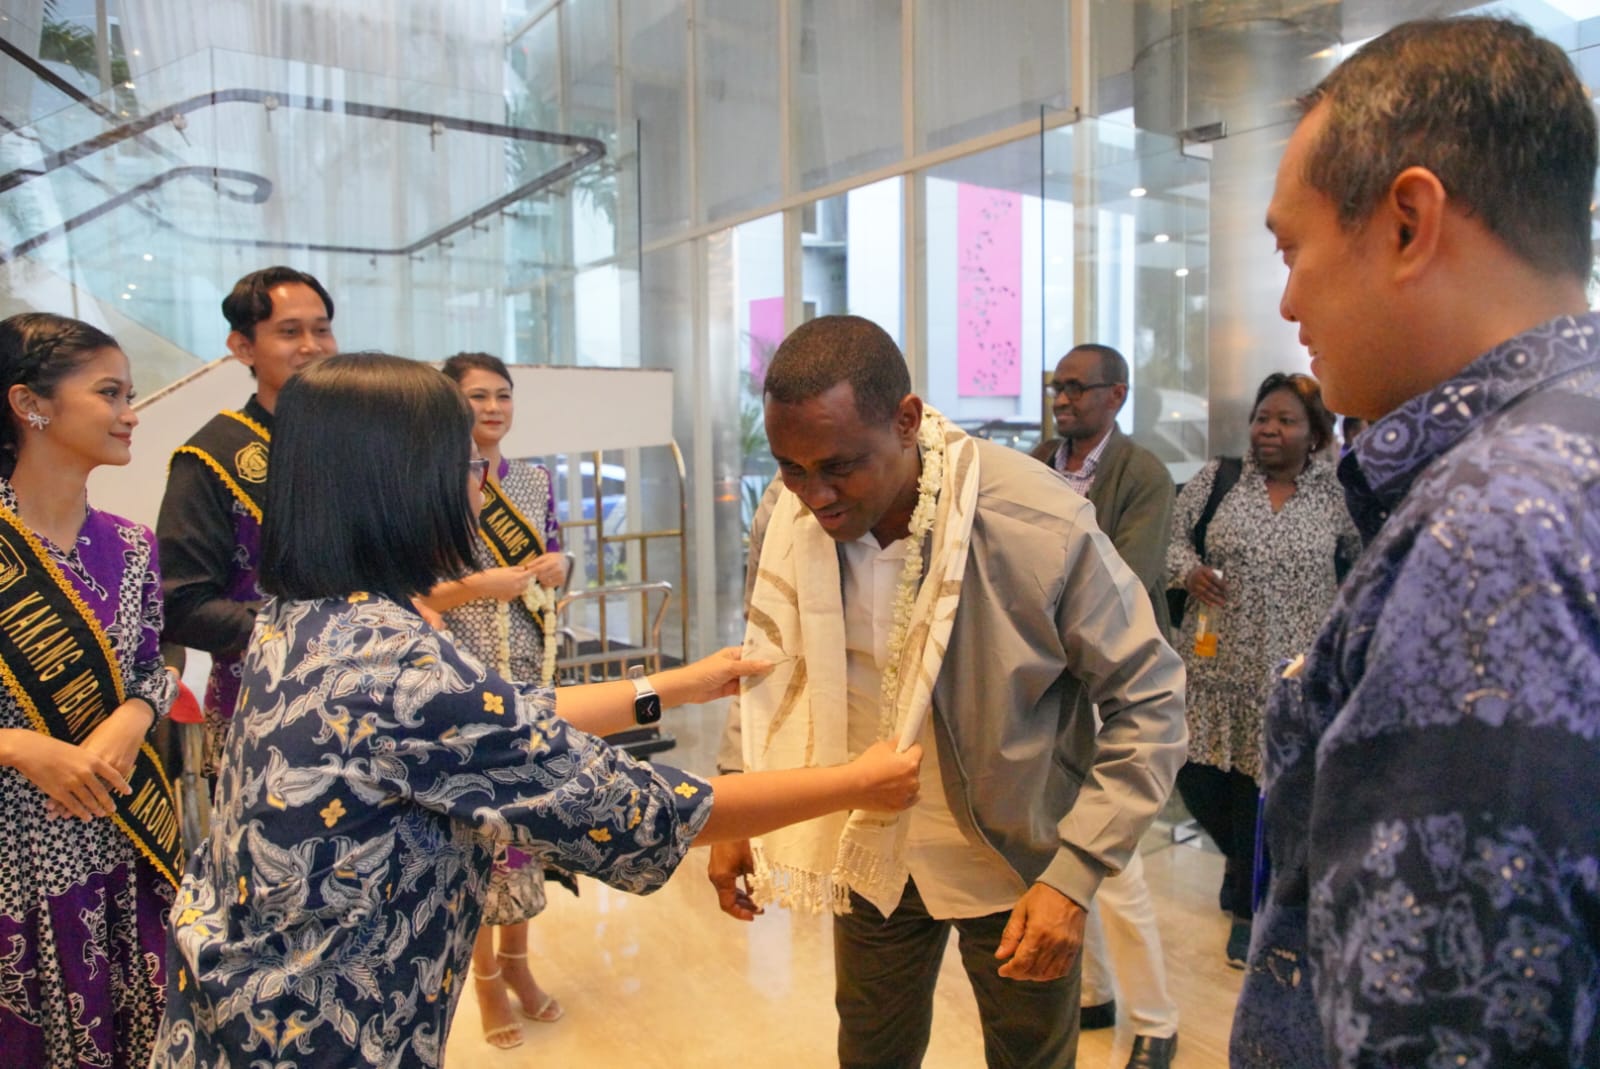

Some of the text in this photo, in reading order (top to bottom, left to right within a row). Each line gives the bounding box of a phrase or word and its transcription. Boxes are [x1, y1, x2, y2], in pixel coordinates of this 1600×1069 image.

[486, 508, 529, 556] KAKANG
[0, 591, 84, 681] KAKANG
[128, 778, 178, 853] MADIUN
